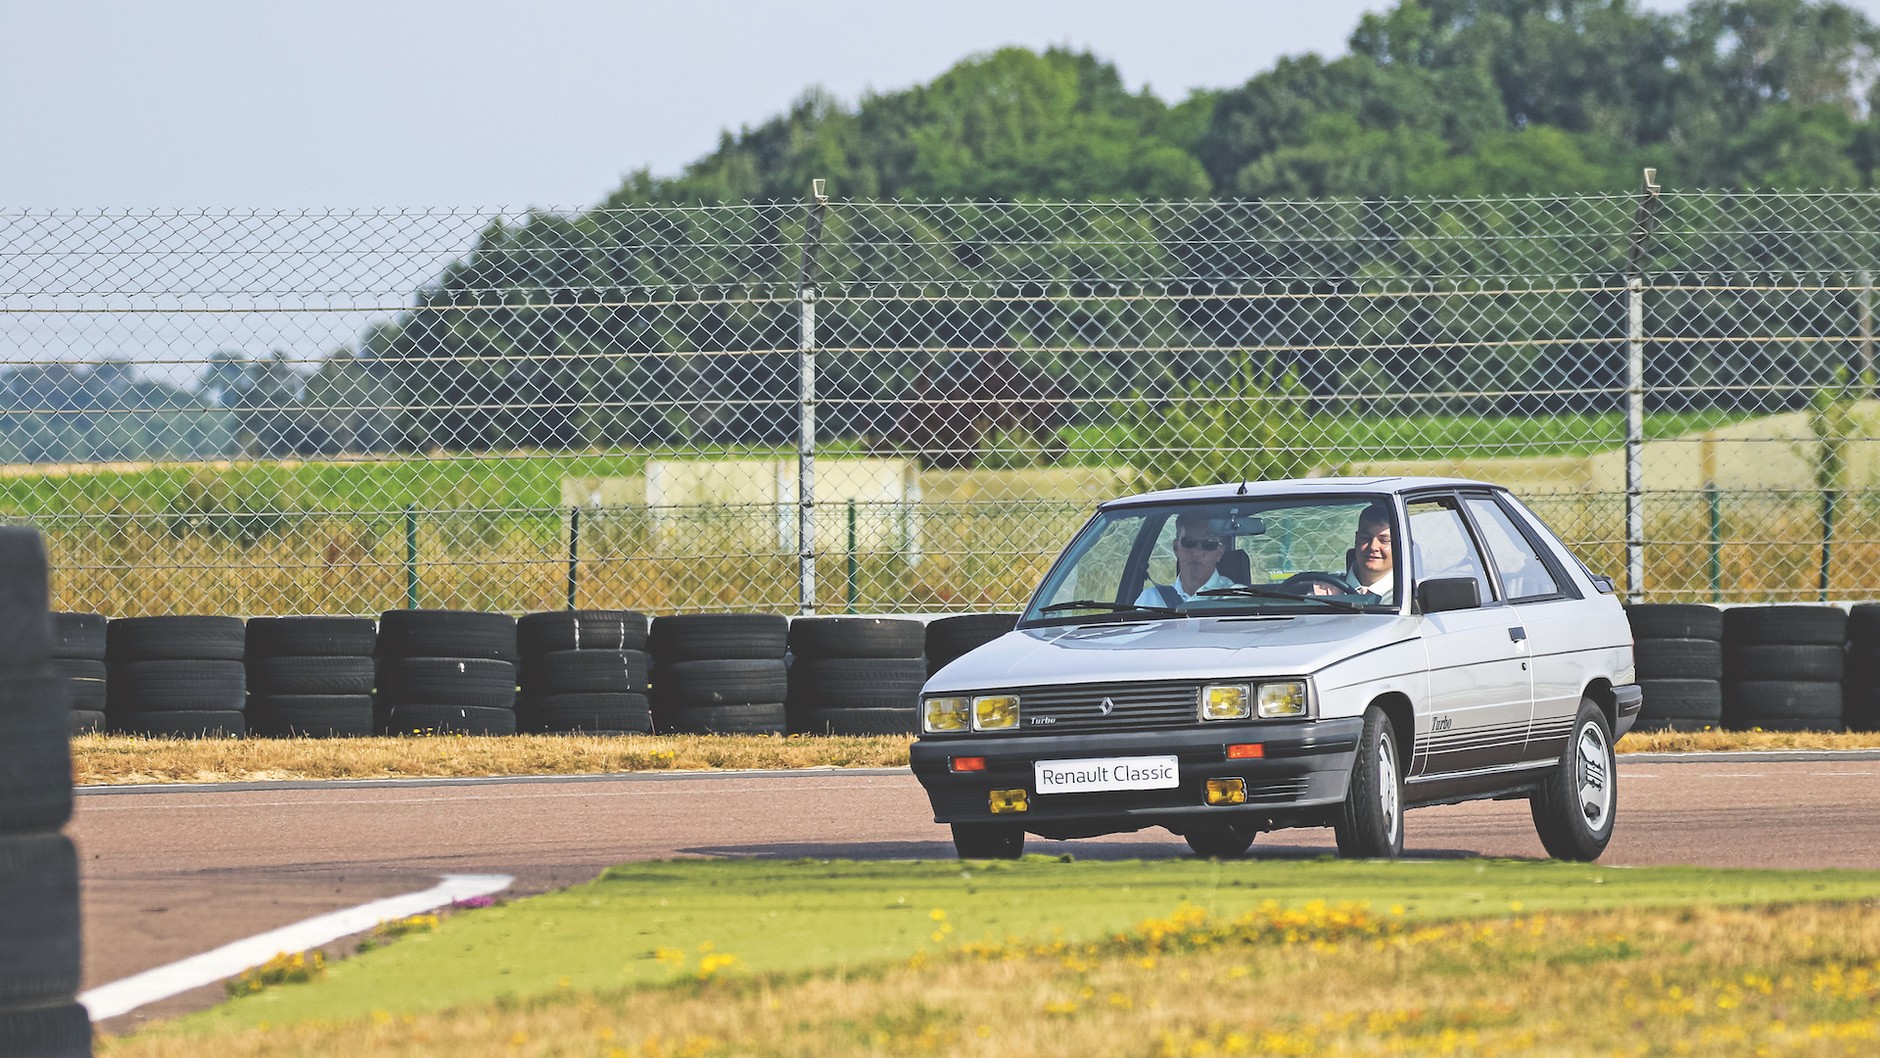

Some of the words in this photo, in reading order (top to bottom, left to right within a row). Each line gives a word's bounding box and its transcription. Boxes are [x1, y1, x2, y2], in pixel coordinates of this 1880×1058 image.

[1030, 716, 1057, 725] Turbo
[1431, 715, 1452, 731] Turbo
[1042, 766, 1109, 785] Renault
[1113, 764, 1173, 782] Classic
